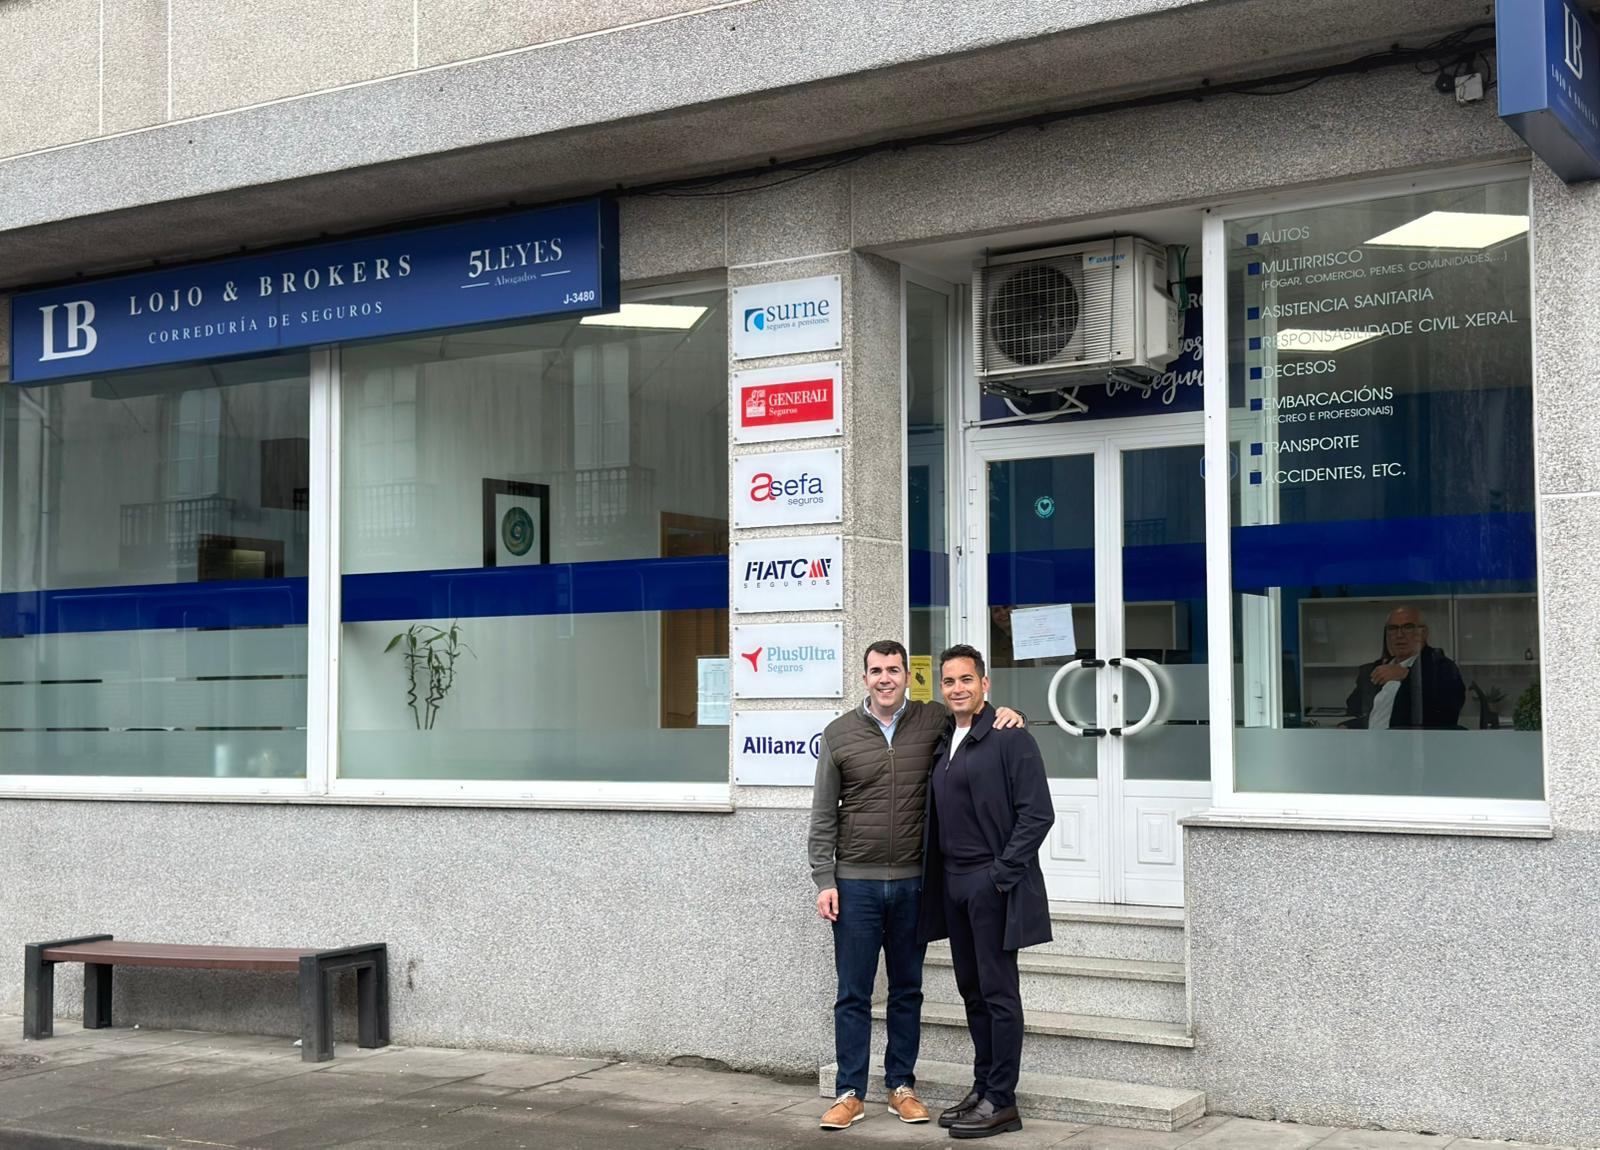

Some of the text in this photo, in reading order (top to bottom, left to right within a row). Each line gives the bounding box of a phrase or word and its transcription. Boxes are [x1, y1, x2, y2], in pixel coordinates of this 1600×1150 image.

[1563, 2, 1583, 80] LB
[1261, 227, 1310, 244] AUTOS
[468, 237, 563, 278] 5LEYES
[1261, 249, 1363, 275] MULTIRRISCO
[129, 254, 412, 316] LOJO & BROKERS
[494, 272, 538, 287] Abogados
[563, 290, 596, 305] J-3480
[1261, 287, 1434, 319] ASISTENCIA SANITARIA
[765, 298, 830, 323] surne
[38, 300, 98, 362] LB
[148, 301, 383, 344] CORREDURÍA DE SEGUROS
[797, 317, 830, 329] pensiones
[1261, 310, 1518, 350] RESPONSABILIDADE CIVIL XERAL
[1262, 359, 1337, 379] DECESOS
[768, 388, 828, 407] GENERALI
[1262, 384, 1394, 410] EMBARCACIÓNS
[768, 406, 798, 417] Seguros
[1309, 411, 1316, 421] E
[1318, 405, 1394, 420] PROFESIONAIS)
[1263, 434, 1360, 454] TRANSPORTE
[1263, 462, 1407, 484] ACCIDENTES, ETC.
[750, 472, 824, 503] asefa
[787, 496, 825, 507] seguros
[743, 579, 832, 589] SEGUROS
[767, 645, 836, 661] PlusUltra
[767, 663, 804, 674] Seguros
[742, 736, 806, 755] Allianz
